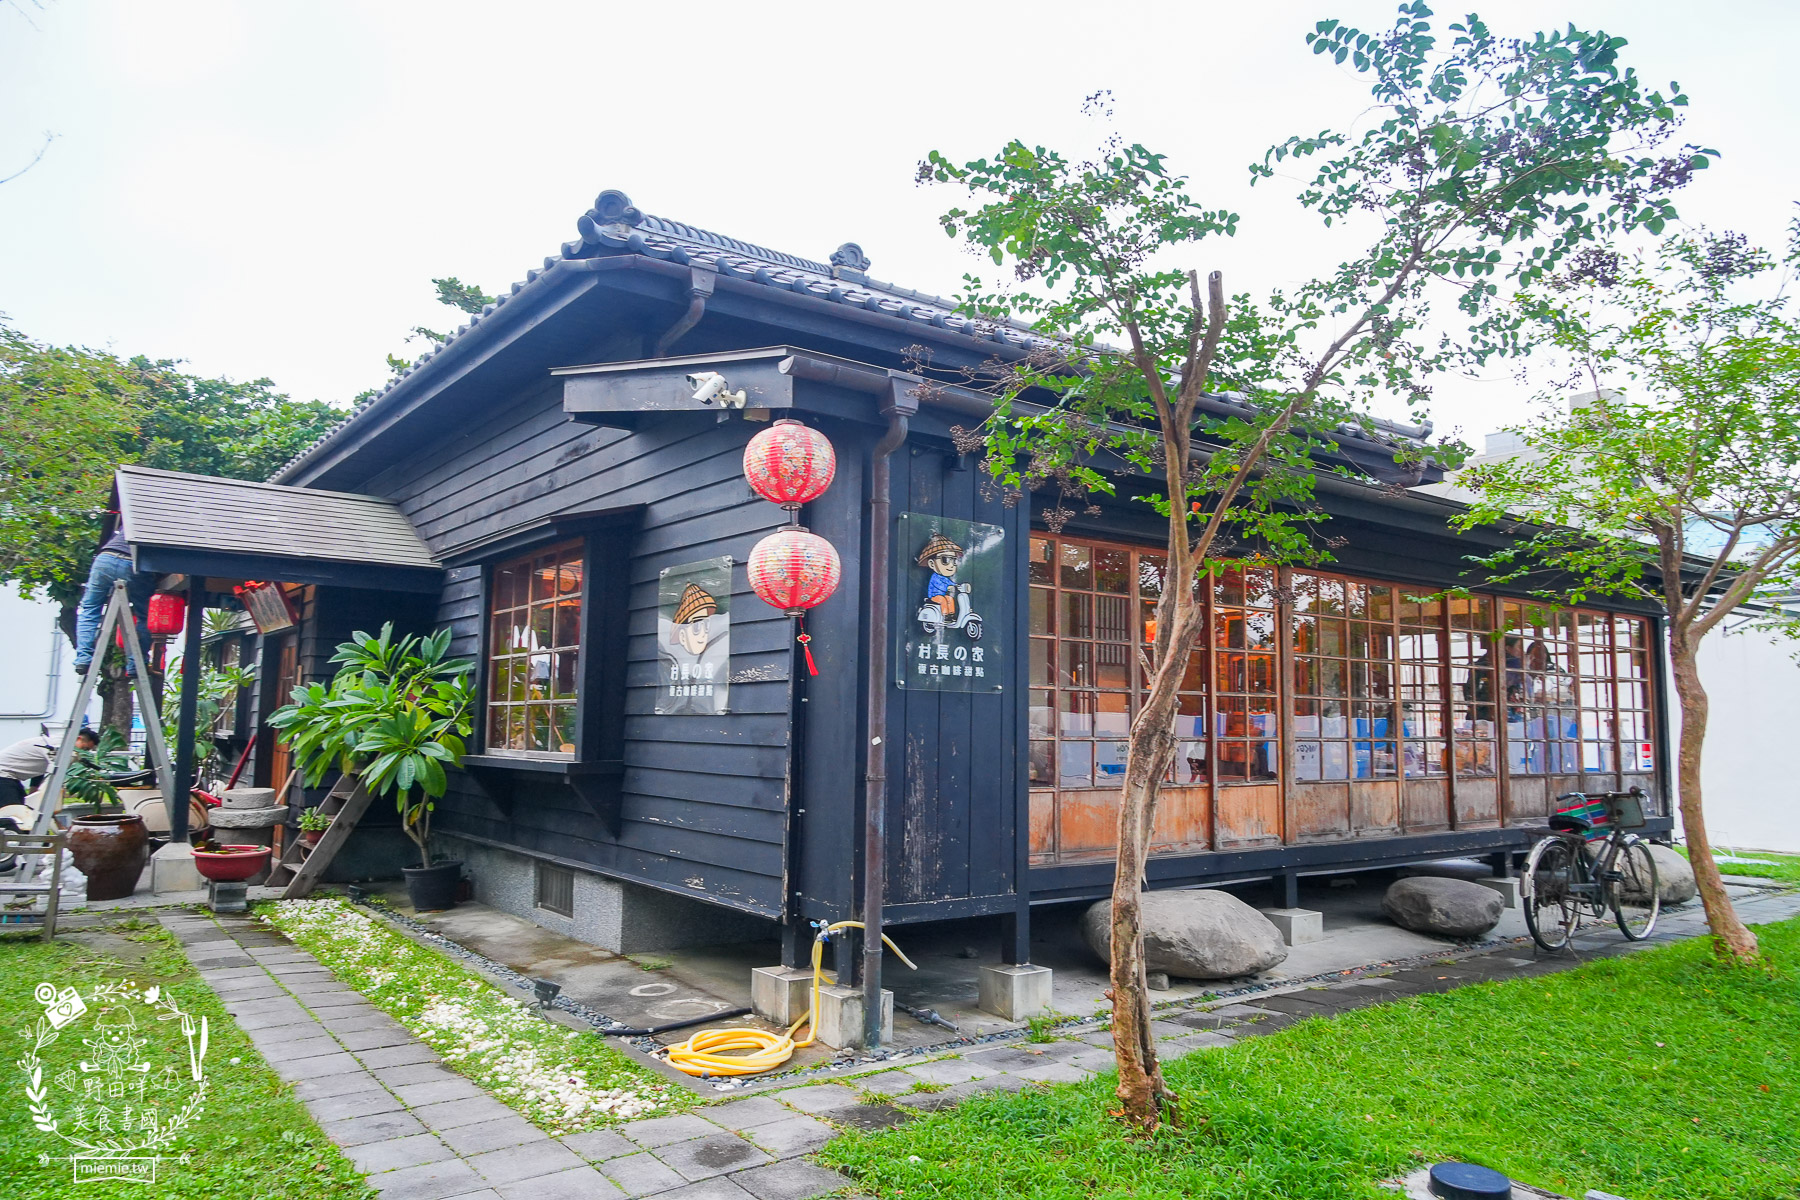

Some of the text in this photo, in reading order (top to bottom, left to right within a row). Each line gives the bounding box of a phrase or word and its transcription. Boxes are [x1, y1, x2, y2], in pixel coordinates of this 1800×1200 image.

[918, 643, 984, 662] 村長の家
[670, 662, 714, 680] 村長の家
